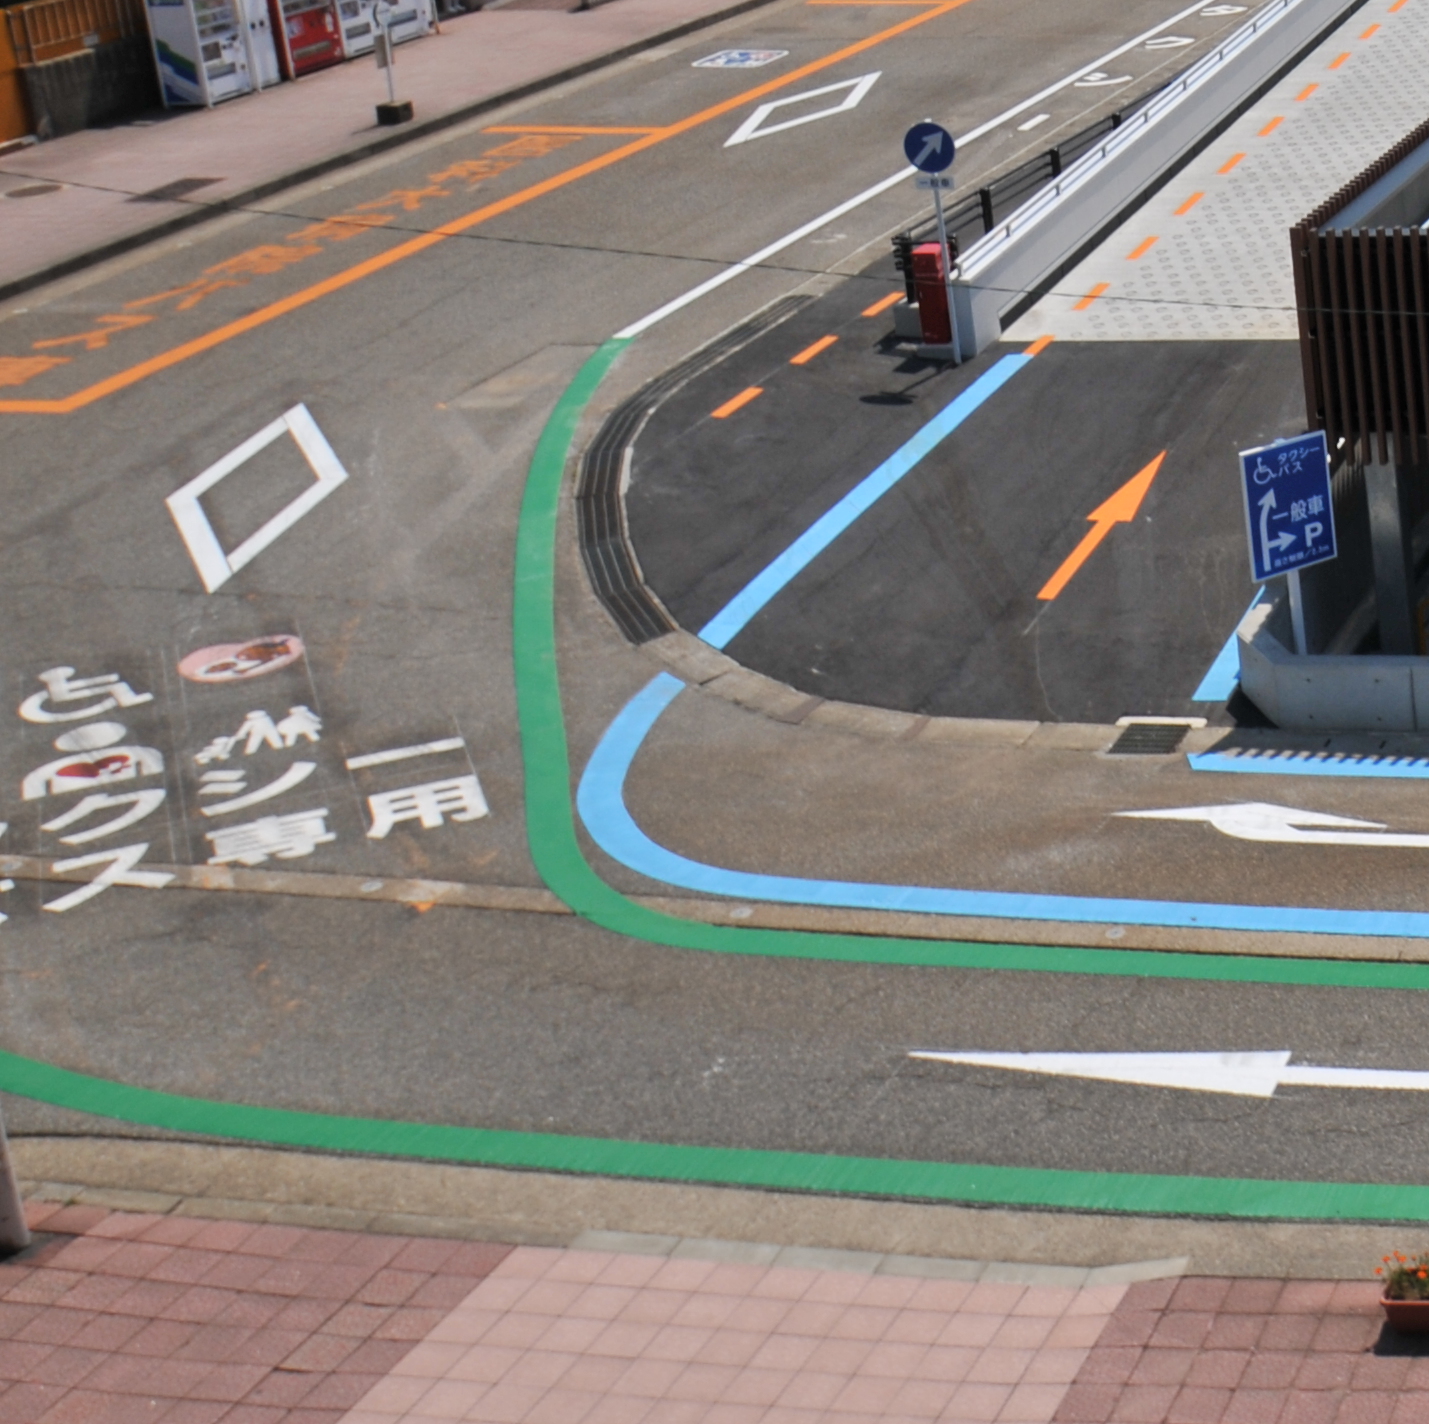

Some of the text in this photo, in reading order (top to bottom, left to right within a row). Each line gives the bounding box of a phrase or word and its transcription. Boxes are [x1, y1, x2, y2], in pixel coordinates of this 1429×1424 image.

[1018, 4, 1248, 132] タクシー
[919, 177, 951, 188] 一般車
[1277, 446, 1321, 464] タクシー
[1278, 462, 1303, 477] バス
[1272, 494, 1325, 523] 一般車
[1304, 521, 1324, 548] P
